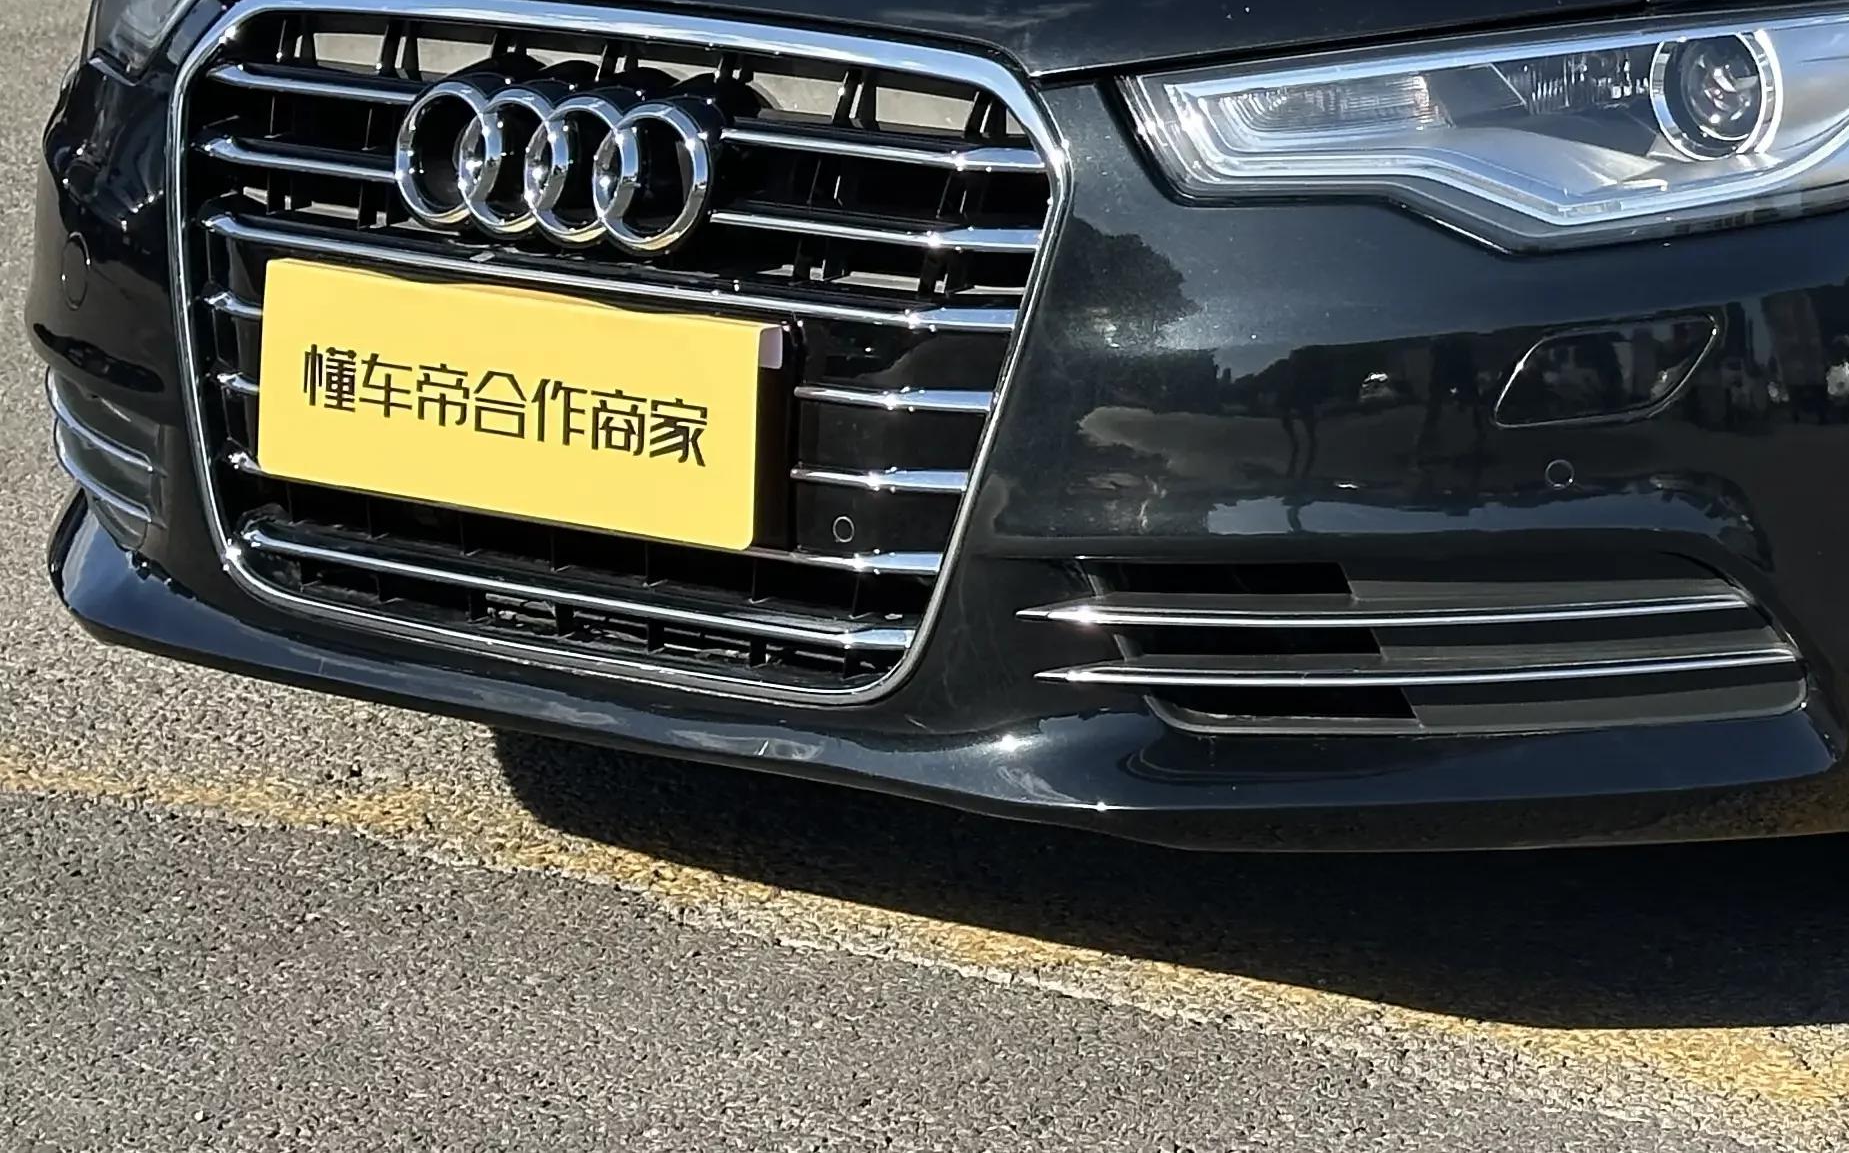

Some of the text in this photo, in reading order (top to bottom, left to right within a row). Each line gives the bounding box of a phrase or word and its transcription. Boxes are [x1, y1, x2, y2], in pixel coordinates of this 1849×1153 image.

[303, 343, 708, 468] 懂车帝合作商家
